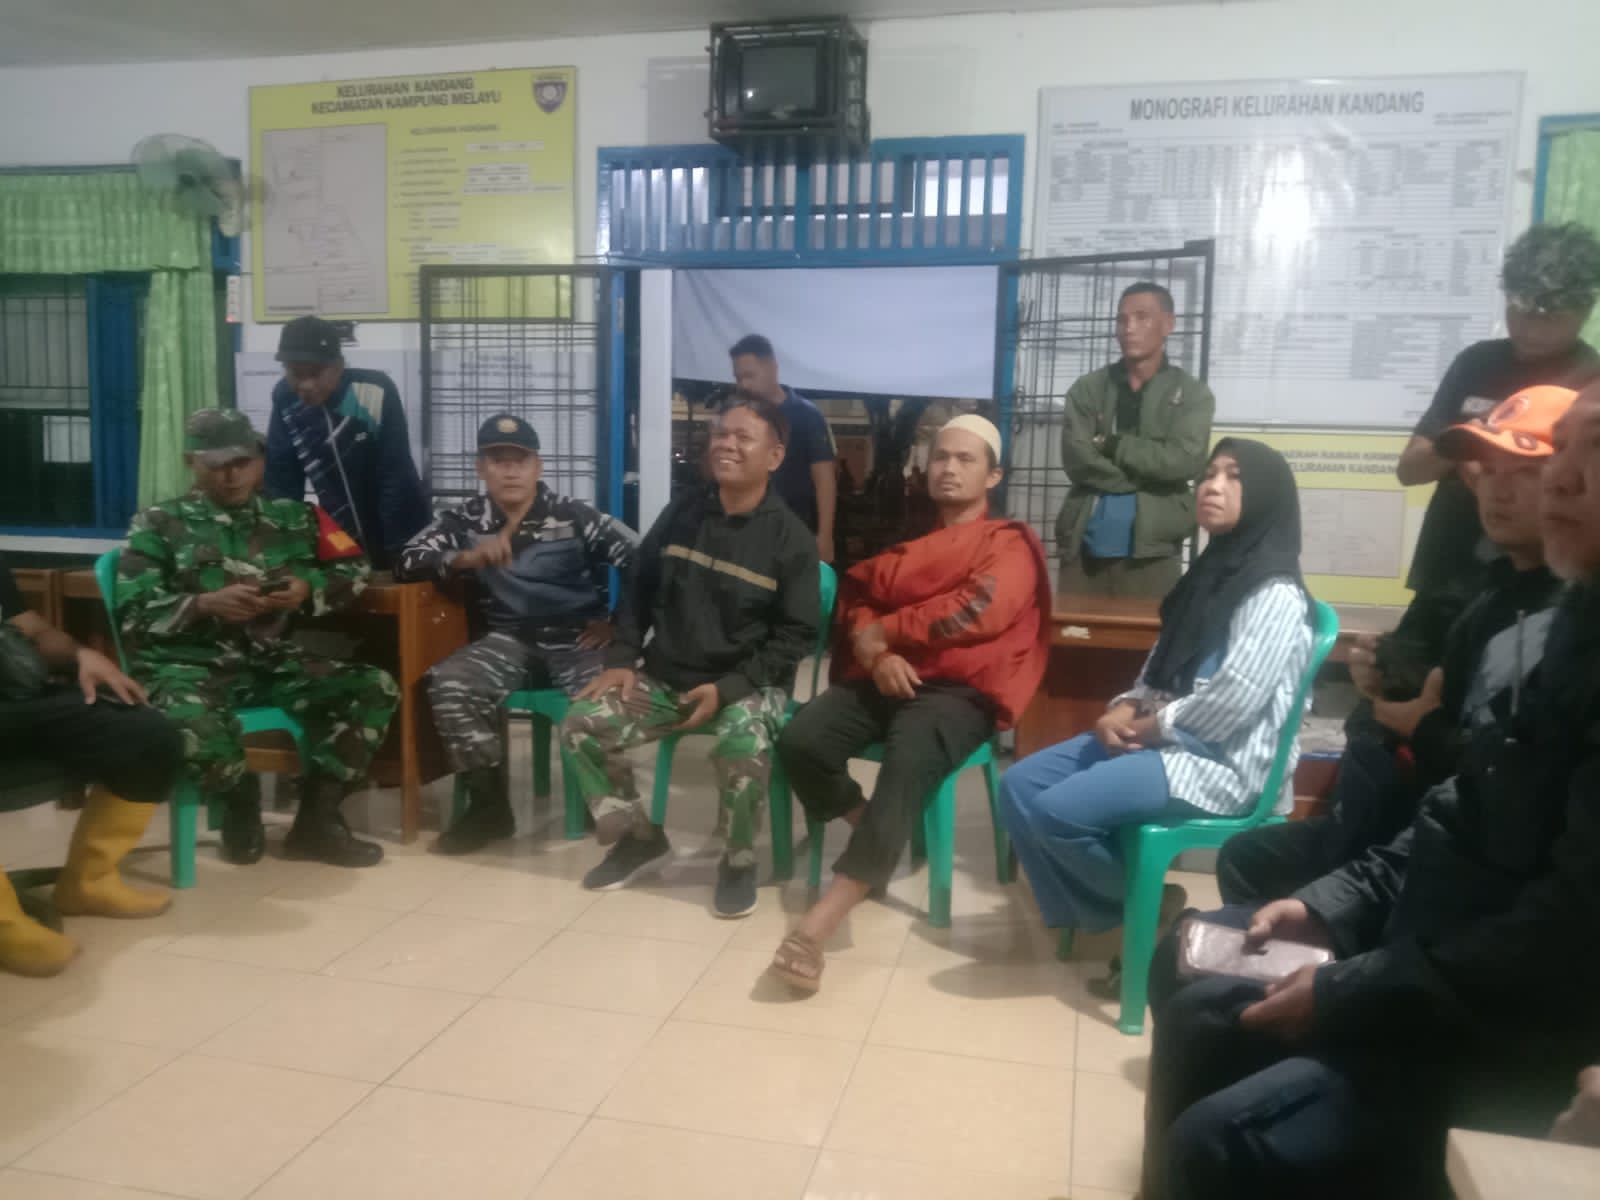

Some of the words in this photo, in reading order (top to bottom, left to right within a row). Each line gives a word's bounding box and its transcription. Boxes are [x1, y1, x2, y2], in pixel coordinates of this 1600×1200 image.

[336, 81, 409, 98] KELURAHAN
[415, 77, 474, 92] KANDANG
[310, 99, 383, 114] KECAMATAN
[386, 93, 449, 109] KAMPUNG
[451, 89, 502, 106] MELAYU
[1129, 96, 1228, 120] MONOGRAFI
[1233, 93, 1336, 117] KELURAHAN
[1339, 90, 1425, 115] KANDANG
